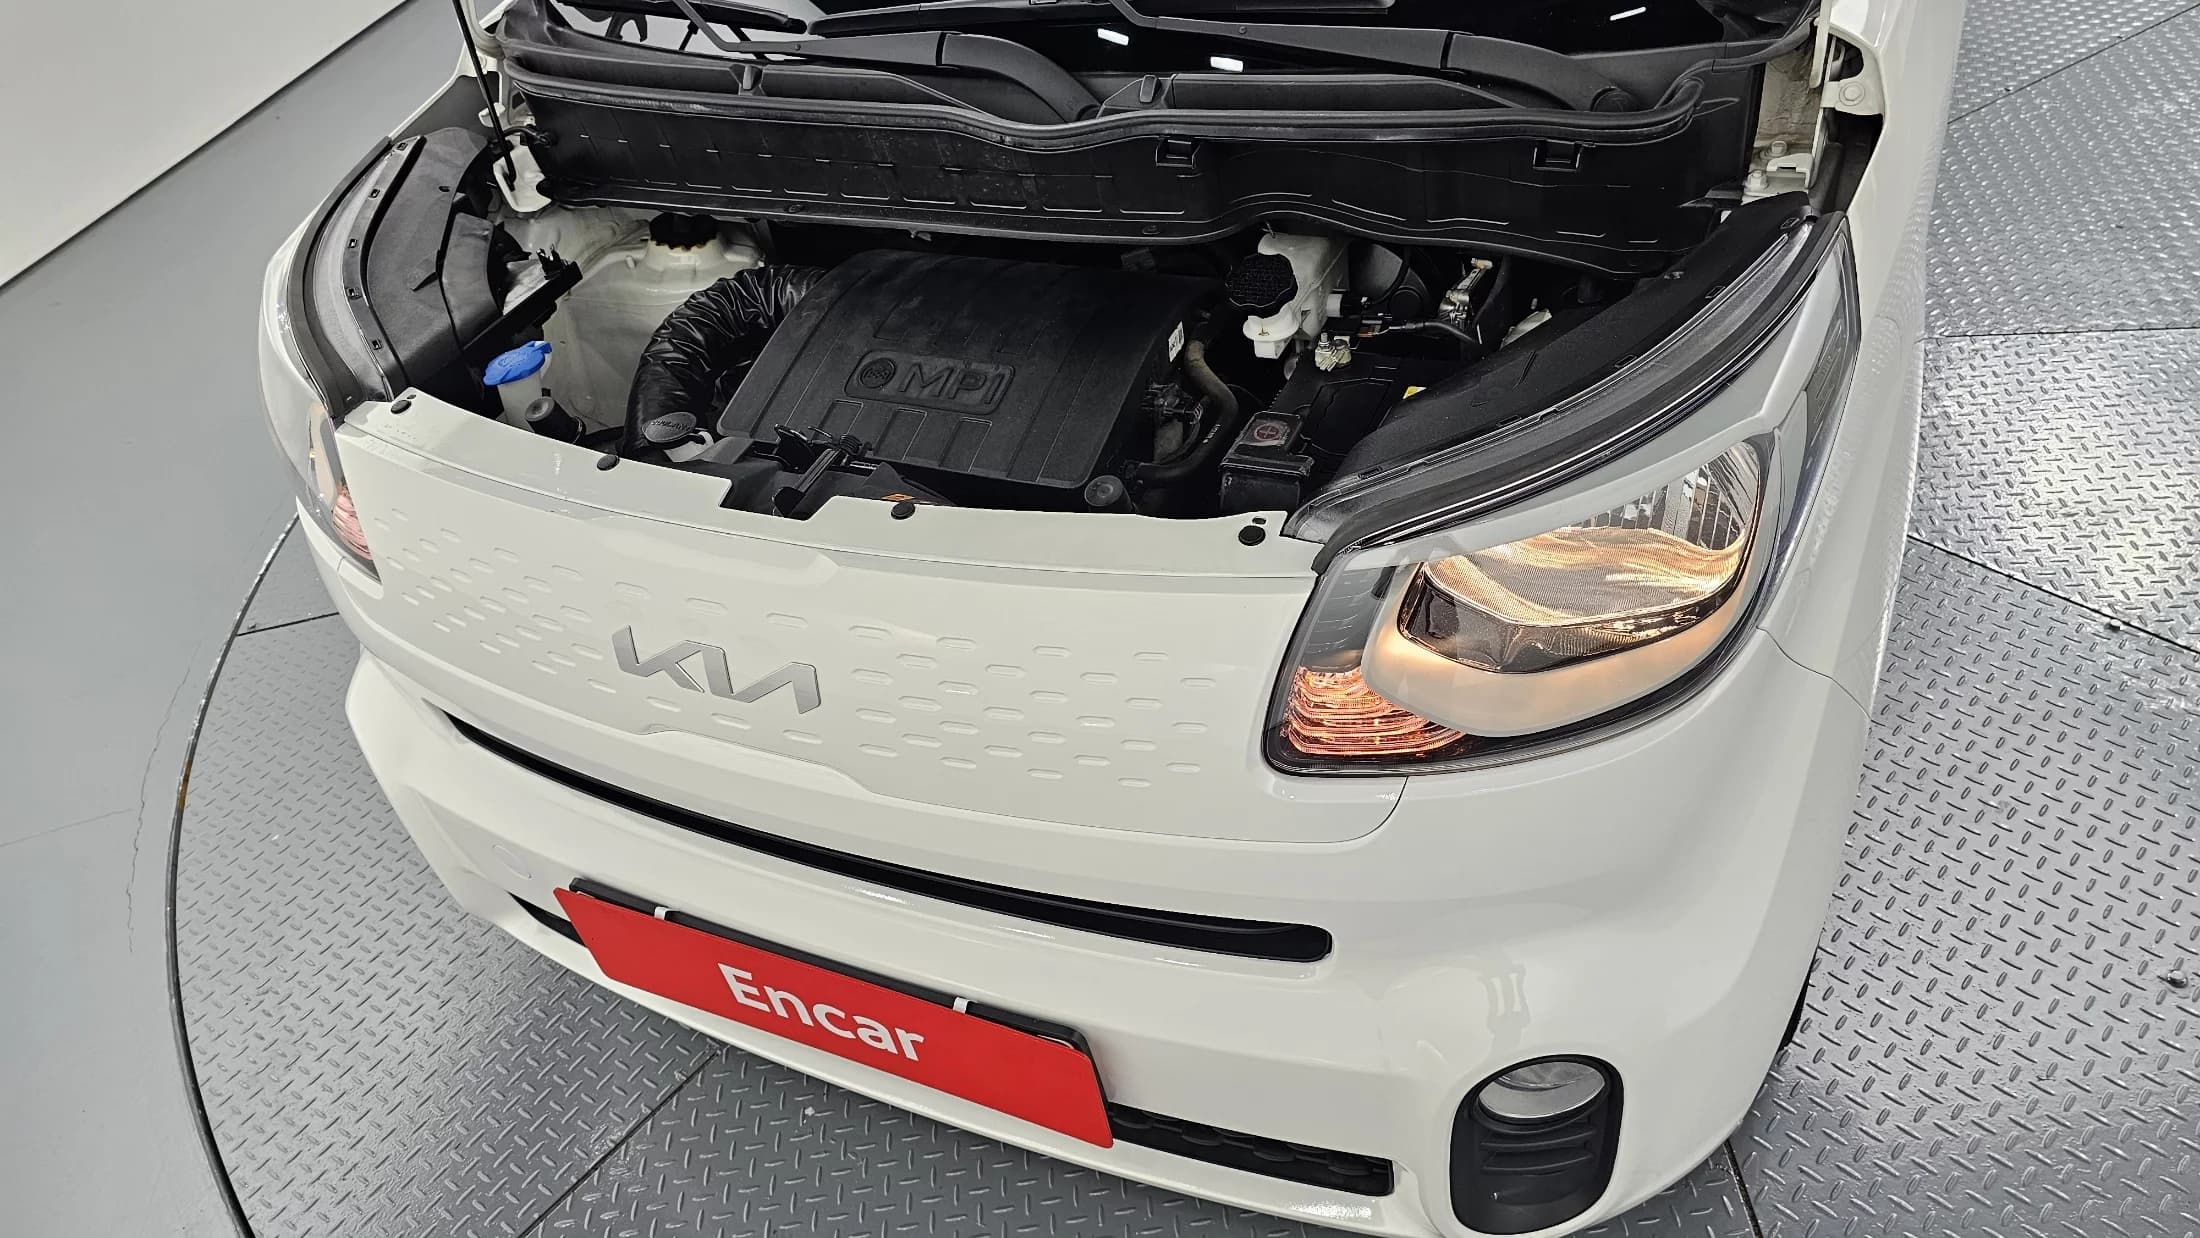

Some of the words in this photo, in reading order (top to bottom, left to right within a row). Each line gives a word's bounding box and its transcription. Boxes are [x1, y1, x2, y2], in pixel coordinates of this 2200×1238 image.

[898, 362, 1006, 405] MPI
[612, 624, 822, 714] KIA
[717, 962, 925, 1062] Encar
